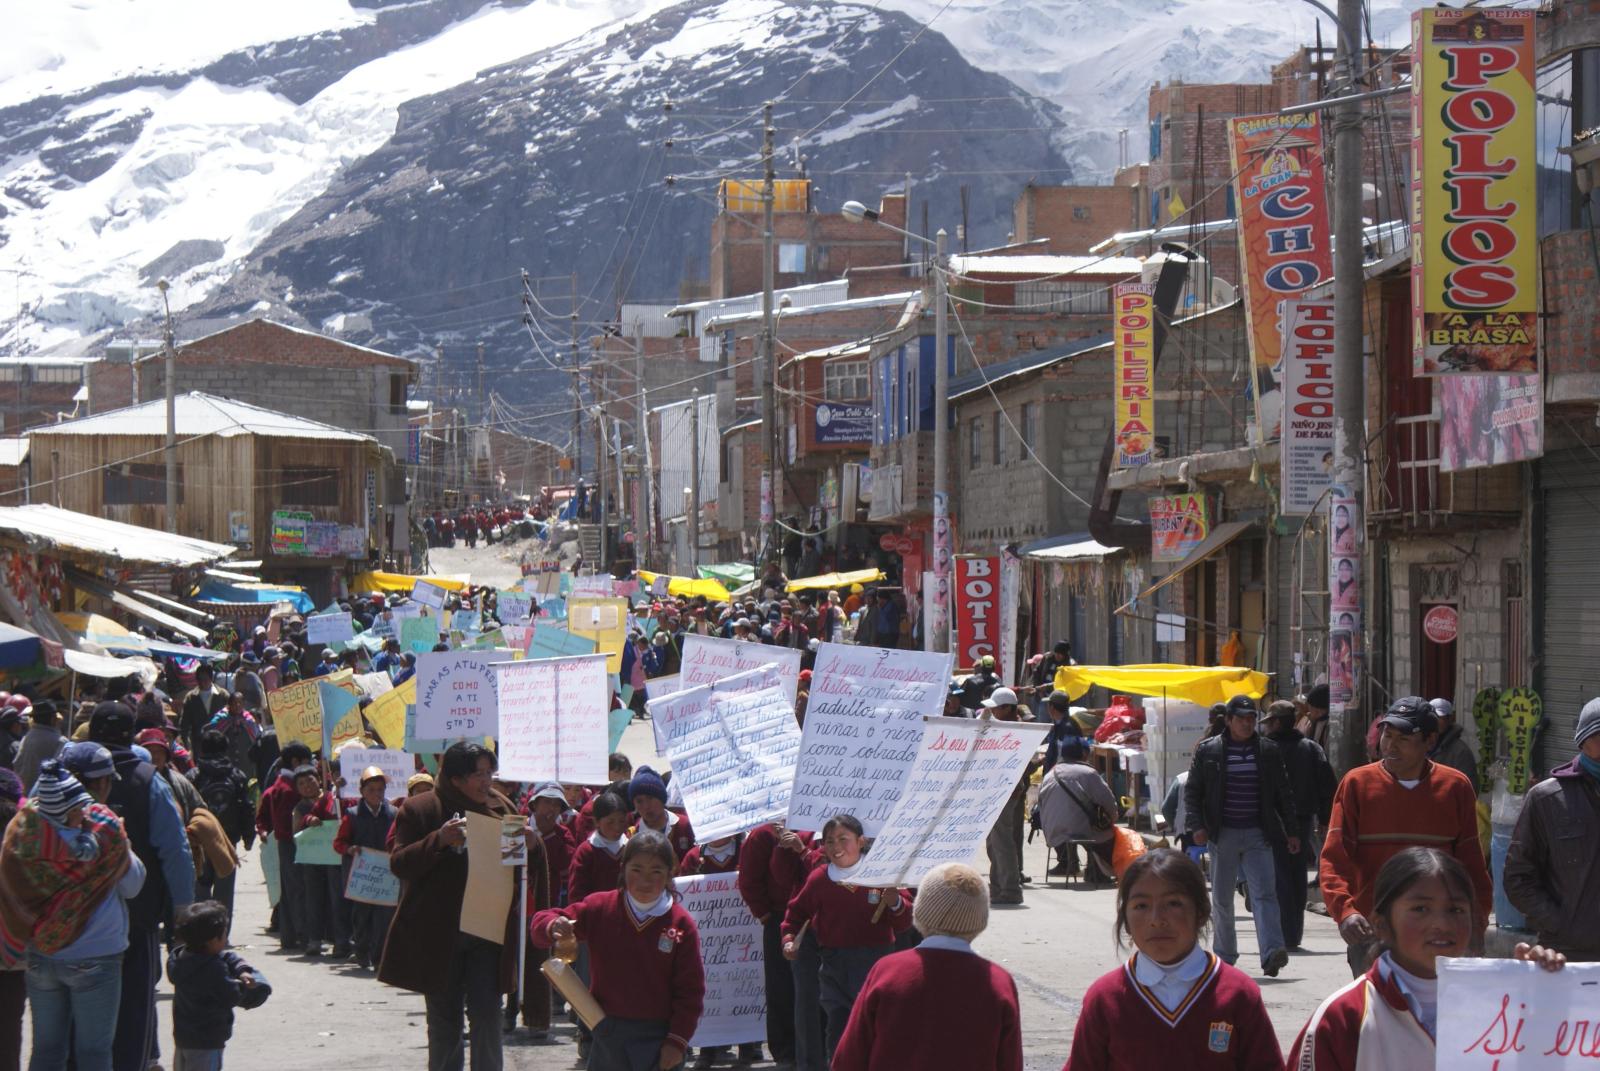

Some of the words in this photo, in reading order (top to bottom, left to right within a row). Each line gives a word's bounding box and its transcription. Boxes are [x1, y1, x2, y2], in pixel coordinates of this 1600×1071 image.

[1434, 10, 1464, 18] LAS
[1237, 112, 1316, 133] CHICKEN
[1245, 184, 1259, 198] LA
[1262, 171, 1293, 190] GRAN
[1442, 45, 1520, 308] POLLOS
[1449, 314, 1468, 325] A
[1486, 314, 1520, 326] LA
[1432, 329, 1530, 345] BRASA
[1120, 297, 1152, 435] POLLERIA
[1291, 420, 1315, 430] NIÑO
[965, 559, 993, 662] BOTIC
[453, 682, 479, 690] COMO
[456, 694, 463, 702] A
[467, 694, 478, 702] TI
[1513, 703, 1528, 713] AL
[812, 699, 876, 718] adultos
[898, 708, 920, 720] no
[804, 743, 847, 756] como
[1514, 716, 1527, 792] INSTANTE
[796, 780, 877, 800] actividad
[1464, 993, 1527, 1056] Si
